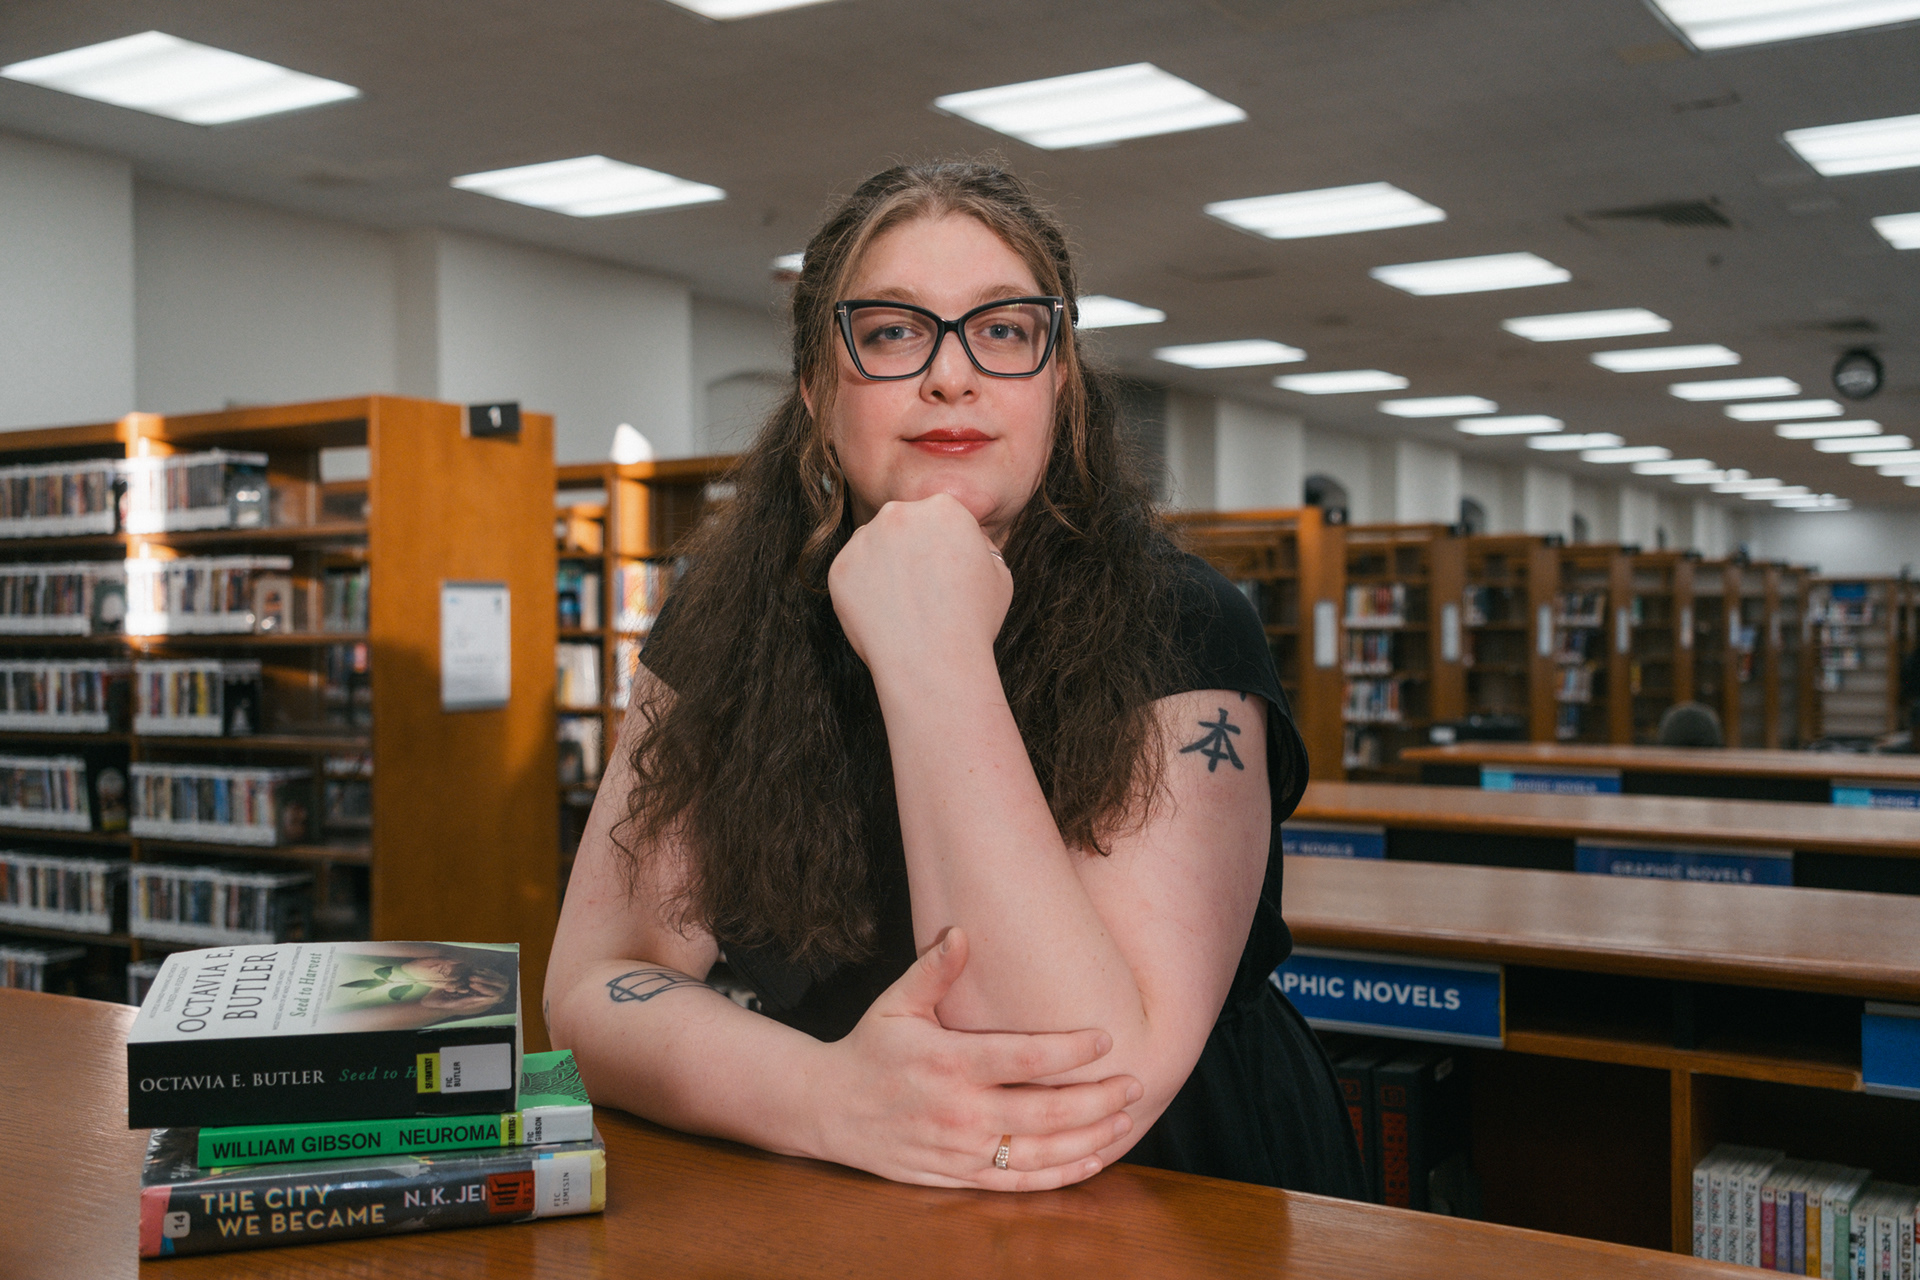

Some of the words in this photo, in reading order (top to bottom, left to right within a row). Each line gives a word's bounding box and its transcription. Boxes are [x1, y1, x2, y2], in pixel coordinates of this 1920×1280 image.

[298, 952, 322, 986] Harvest
[176, 963, 230, 1033] OCTAVIA
[205, 949, 235, 960] E.
[223, 951, 279, 1021] BUTLER
[298, 986, 313, 996] to
[1353, 978, 1461, 1011] NOVELS
[289, 997, 311, 1018] Seed
[139, 1074, 225, 1093] OCTAVIA
[231, 1073, 246, 1088] E.
[252, 1069, 326, 1088] BUTLER
[338, 1065, 378, 1082] Seed
[383, 1067, 398, 1079] to
[445, 1076, 453, 1088] FIC
[453, 1061, 461, 1088] BUTLER
[526, 1131, 535, 1143] FIC
[534, 1116, 542, 1142] GIBSON
[212, 1138, 295, 1160] WILLIAM
[301, 1132, 382, 1153] GIBSON
[399, 1124, 499, 1147] NEUROMA
[200, 1190, 256, 1215] THE
[264, 1183, 331, 1209] CITY
[403, 1189, 428, 1209] N.
[430, 1187, 452, 1206] K.
[553, 1192, 561, 1207] FIC
[173, 1213, 187, 1231] 14
[216, 1214, 262, 1238] WE
[271, 1203, 387, 1234] BECAME
